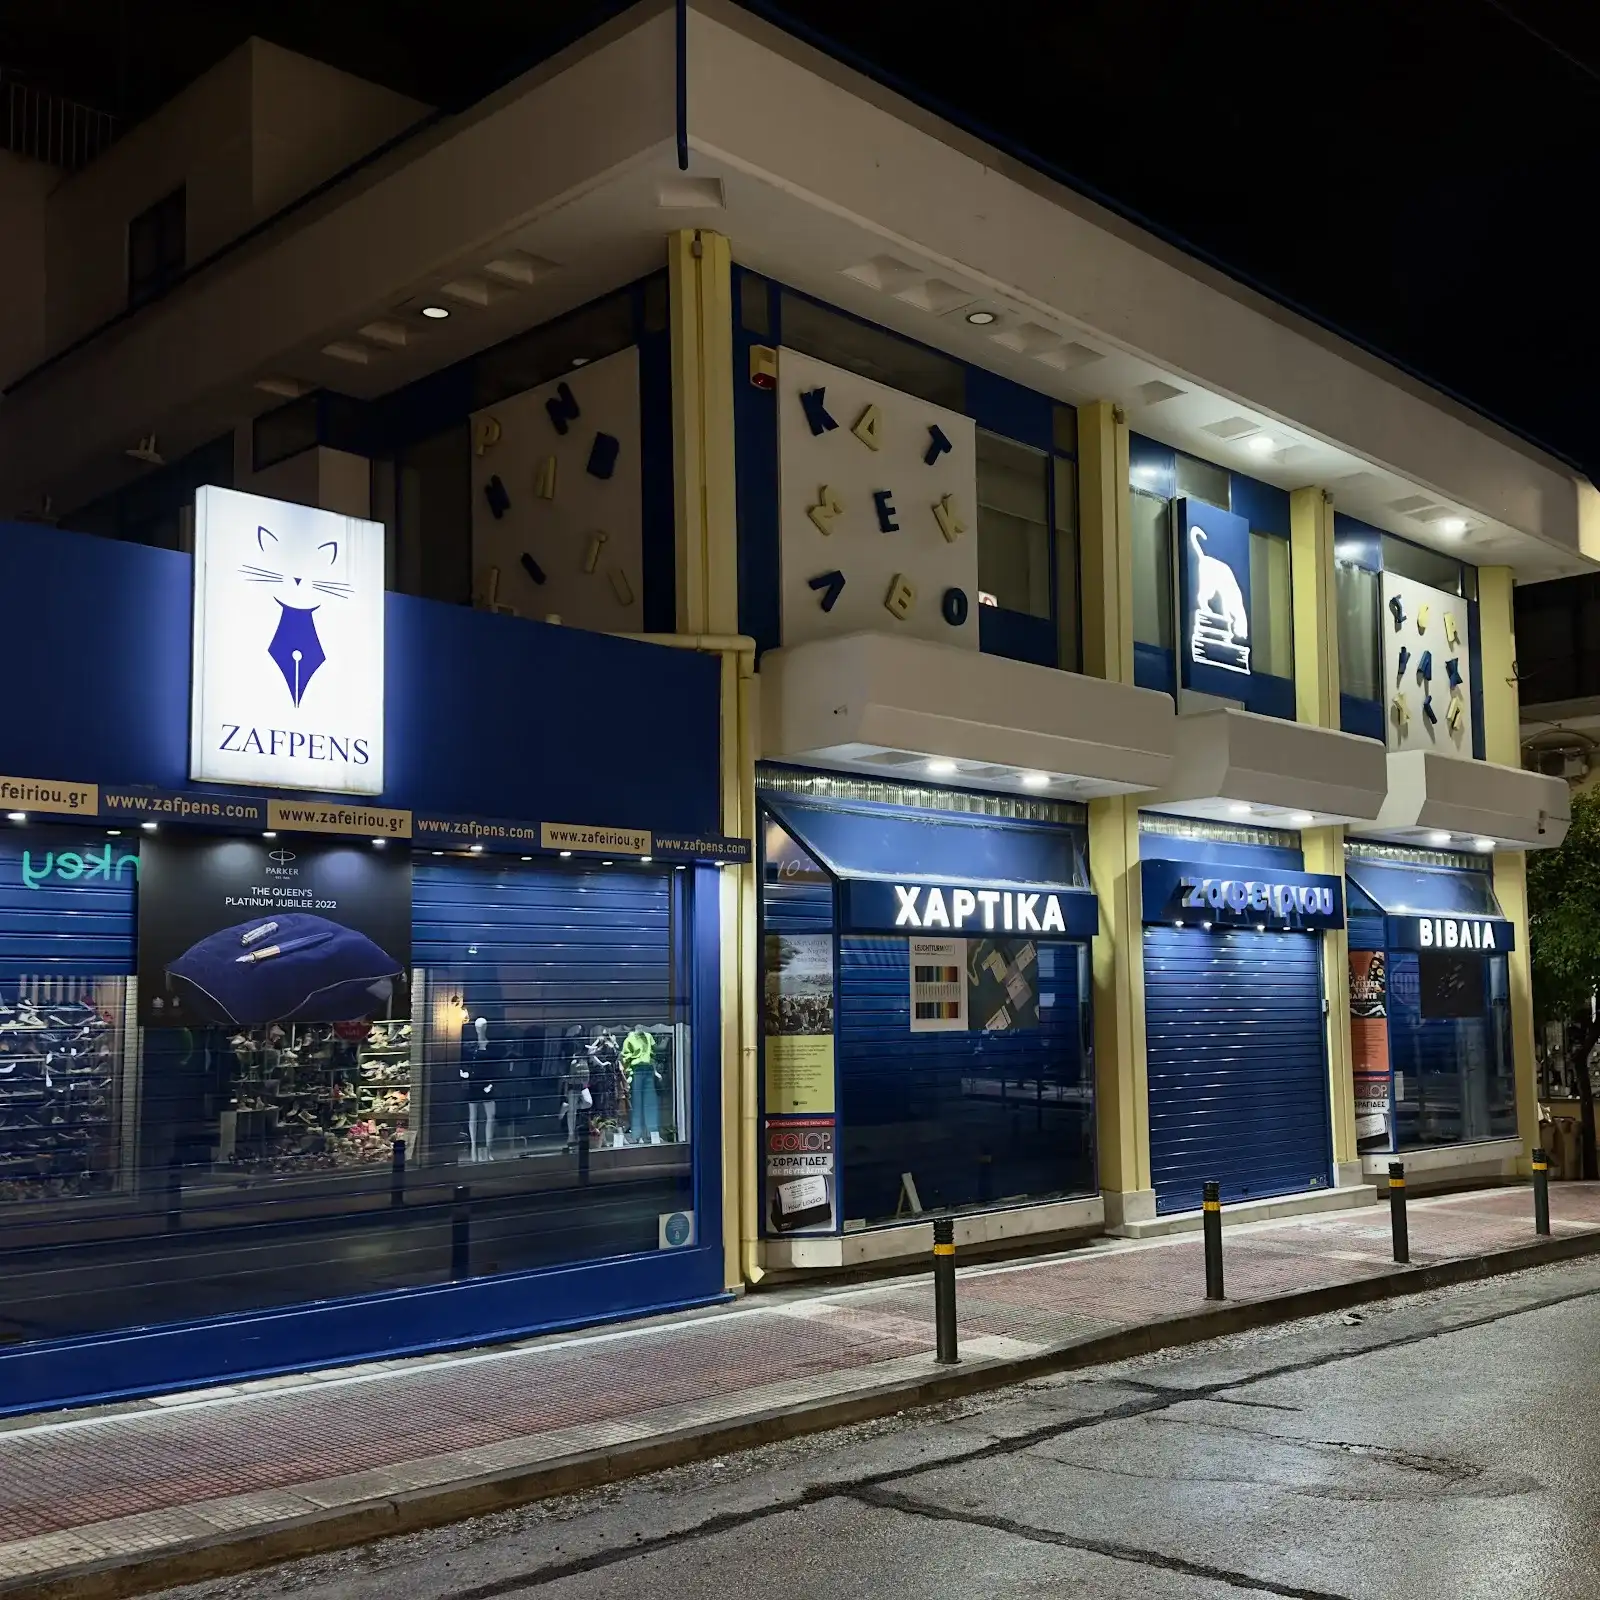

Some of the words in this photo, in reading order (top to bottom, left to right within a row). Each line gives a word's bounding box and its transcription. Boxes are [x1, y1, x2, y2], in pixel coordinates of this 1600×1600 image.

[218, 724, 369, 765] ZAFPENS
[105, 793, 259, 820] www.zafpens.com
[278, 806, 405, 832] www.zafeiriou.gr
[417, 818, 535, 839] www.zafpens.com
[549, 828, 646, 849] www.zafeiriou.gr
[656, 837, 747, 855] www.zafpens.com
[265, 867, 299, 876] PARKER
[251, 886, 271, 896] THE
[272, 888, 313, 897] QUEEN'S
[225, 897, 274, 907] PLATINUM
[275, 898, 313, 908] JUBILEE
[315, 900, 337, 909] 2022
[894, 885, 1067, 932] ΧΑΡΤΙΚΑ
[1419, 918, 1496, 949] ΒΙΒΛΙΑ
[772, 1156, 828, 1167] ΣΦΡΑΓΙΔΕΣ
